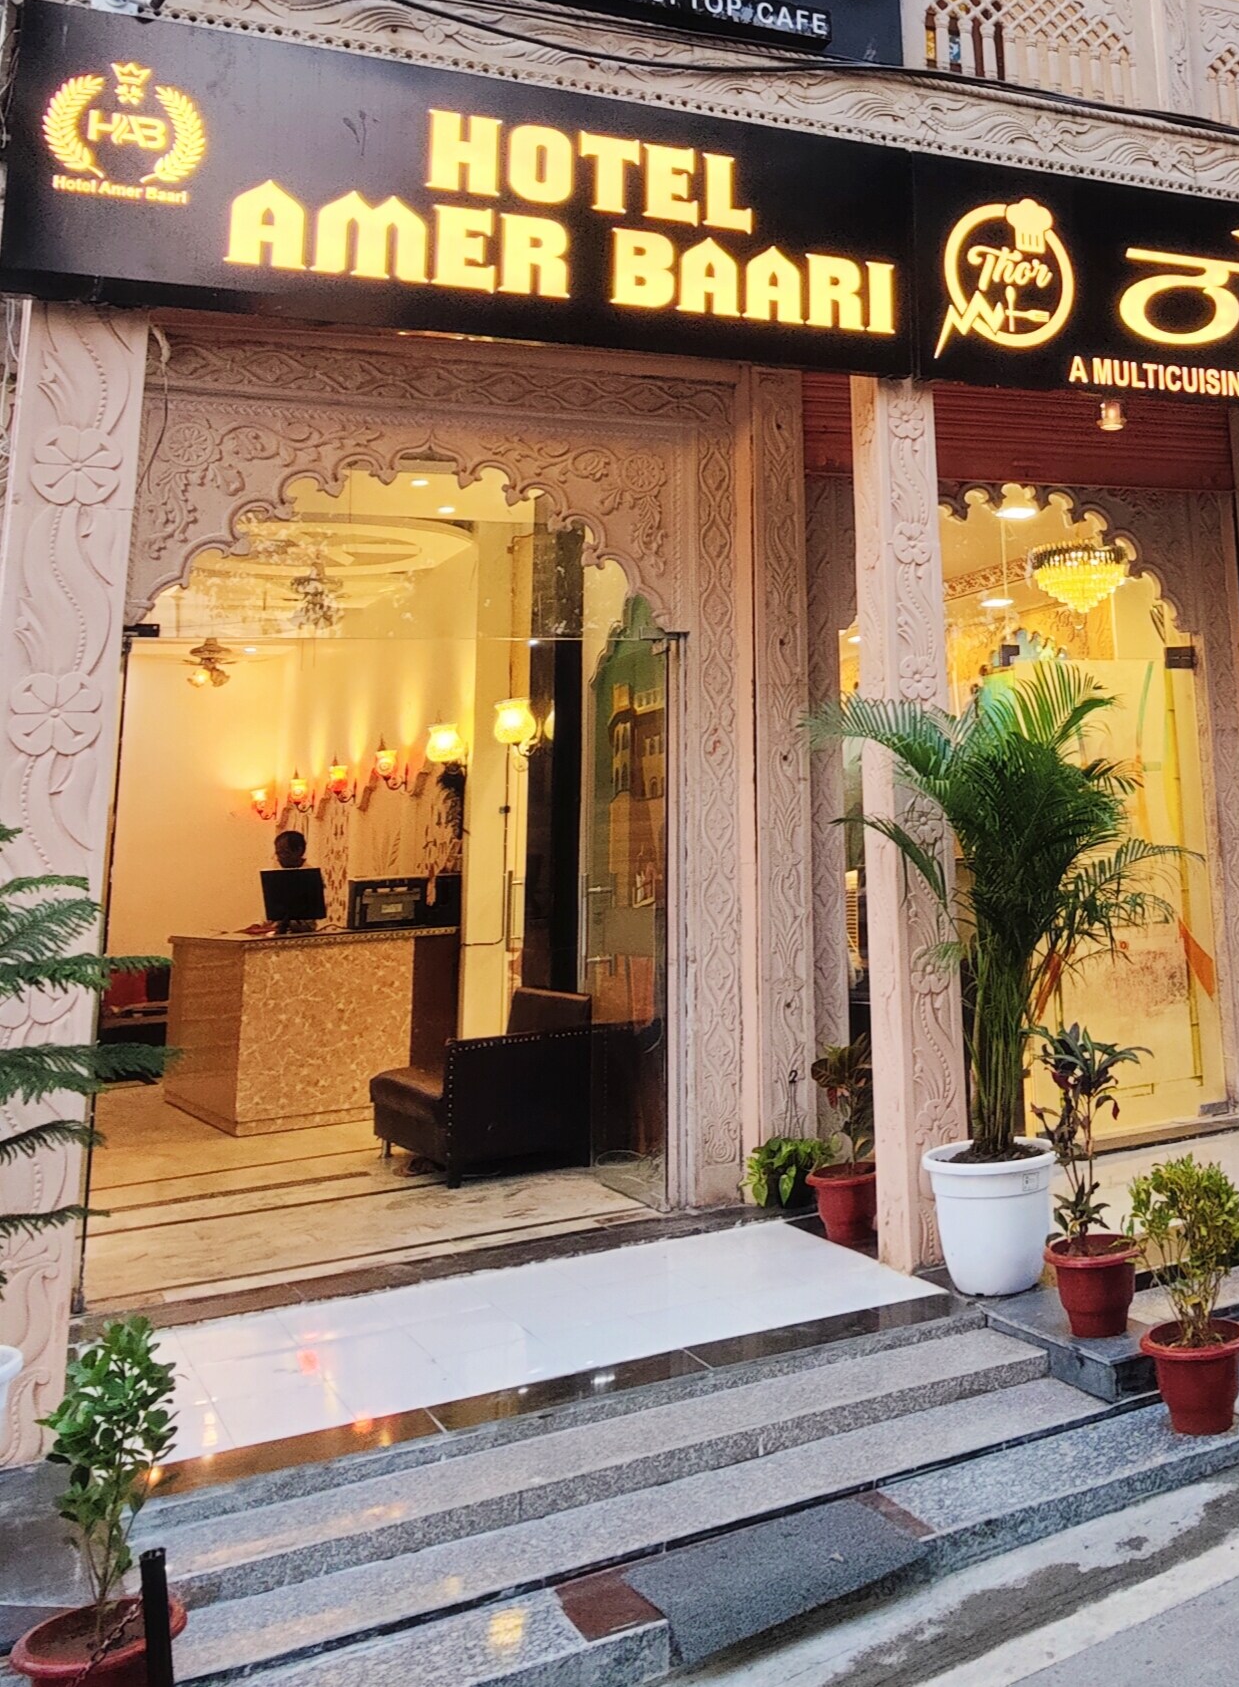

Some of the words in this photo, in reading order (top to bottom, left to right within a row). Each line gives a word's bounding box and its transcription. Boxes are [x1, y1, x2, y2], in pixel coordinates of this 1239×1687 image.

[757, 1, 828, 35] CAFE
[52, 174, 97, 193] Hotel
[98, 181, 144, 199] Amer
[145, 186, 188, 204] Baari
[425, 108, 753, 234] HOTEL
[222, 179, 571, 299] AMER
[609, 226, 895, 335] BAARI
[967, 244, 1054, 292] Thor
[1069, 355, 1088, 383] A
